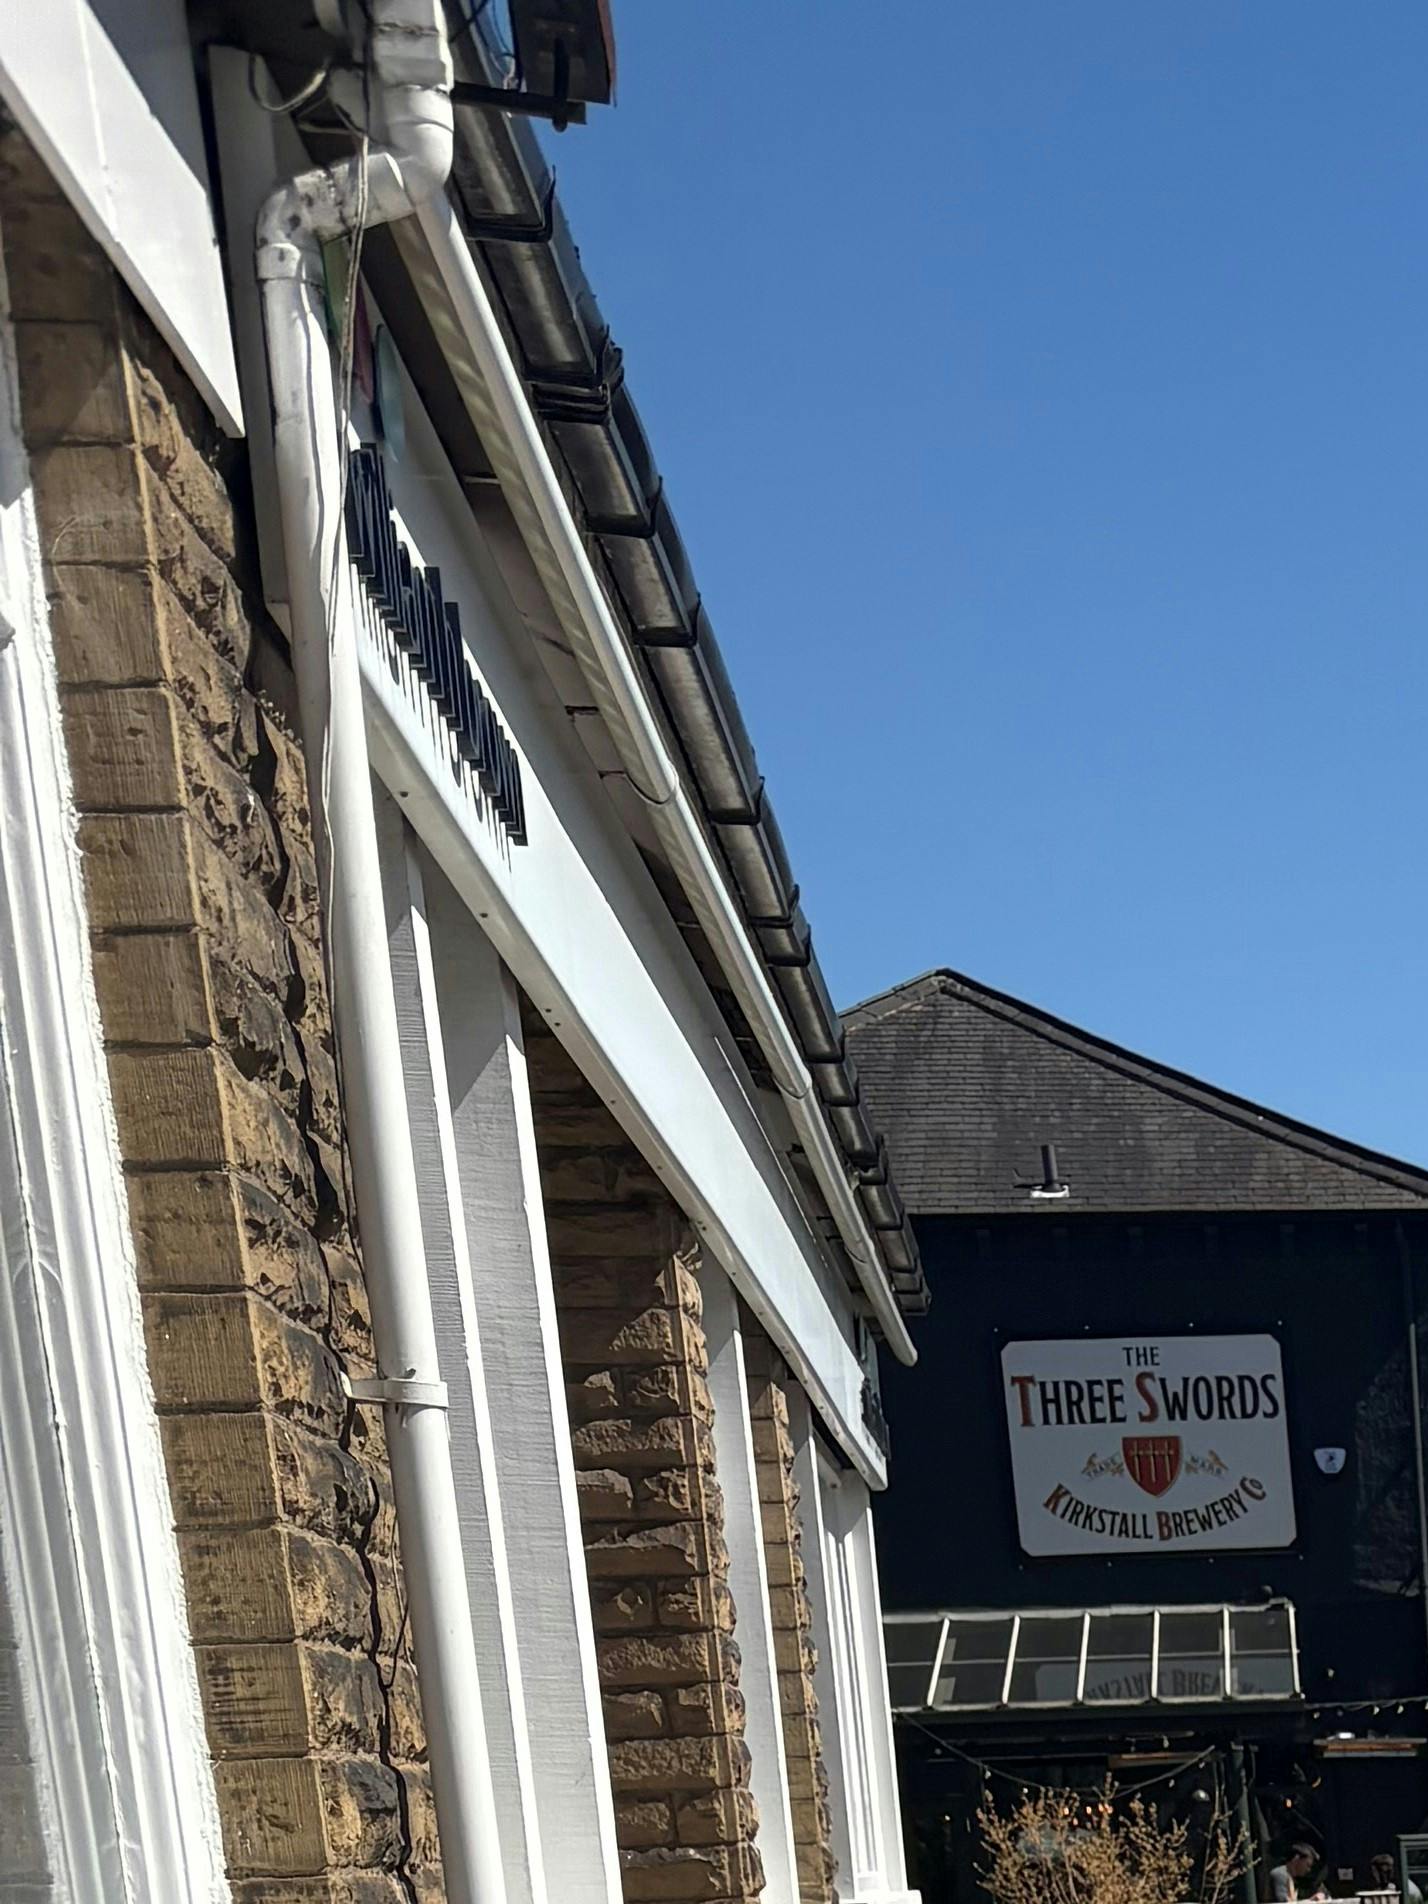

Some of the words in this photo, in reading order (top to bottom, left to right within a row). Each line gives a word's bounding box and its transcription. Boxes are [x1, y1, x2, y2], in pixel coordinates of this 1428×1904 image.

[1121, 1346, 1161, 1367] THE
[1010, 1375, 1127, 1427] THREE
[1135, 1371, 1280, 1423] SWORDS
[1042, 1483, 1153, 1540] KIRKSTALL
[1156, 1489, 1248, 1541] BREWERY
